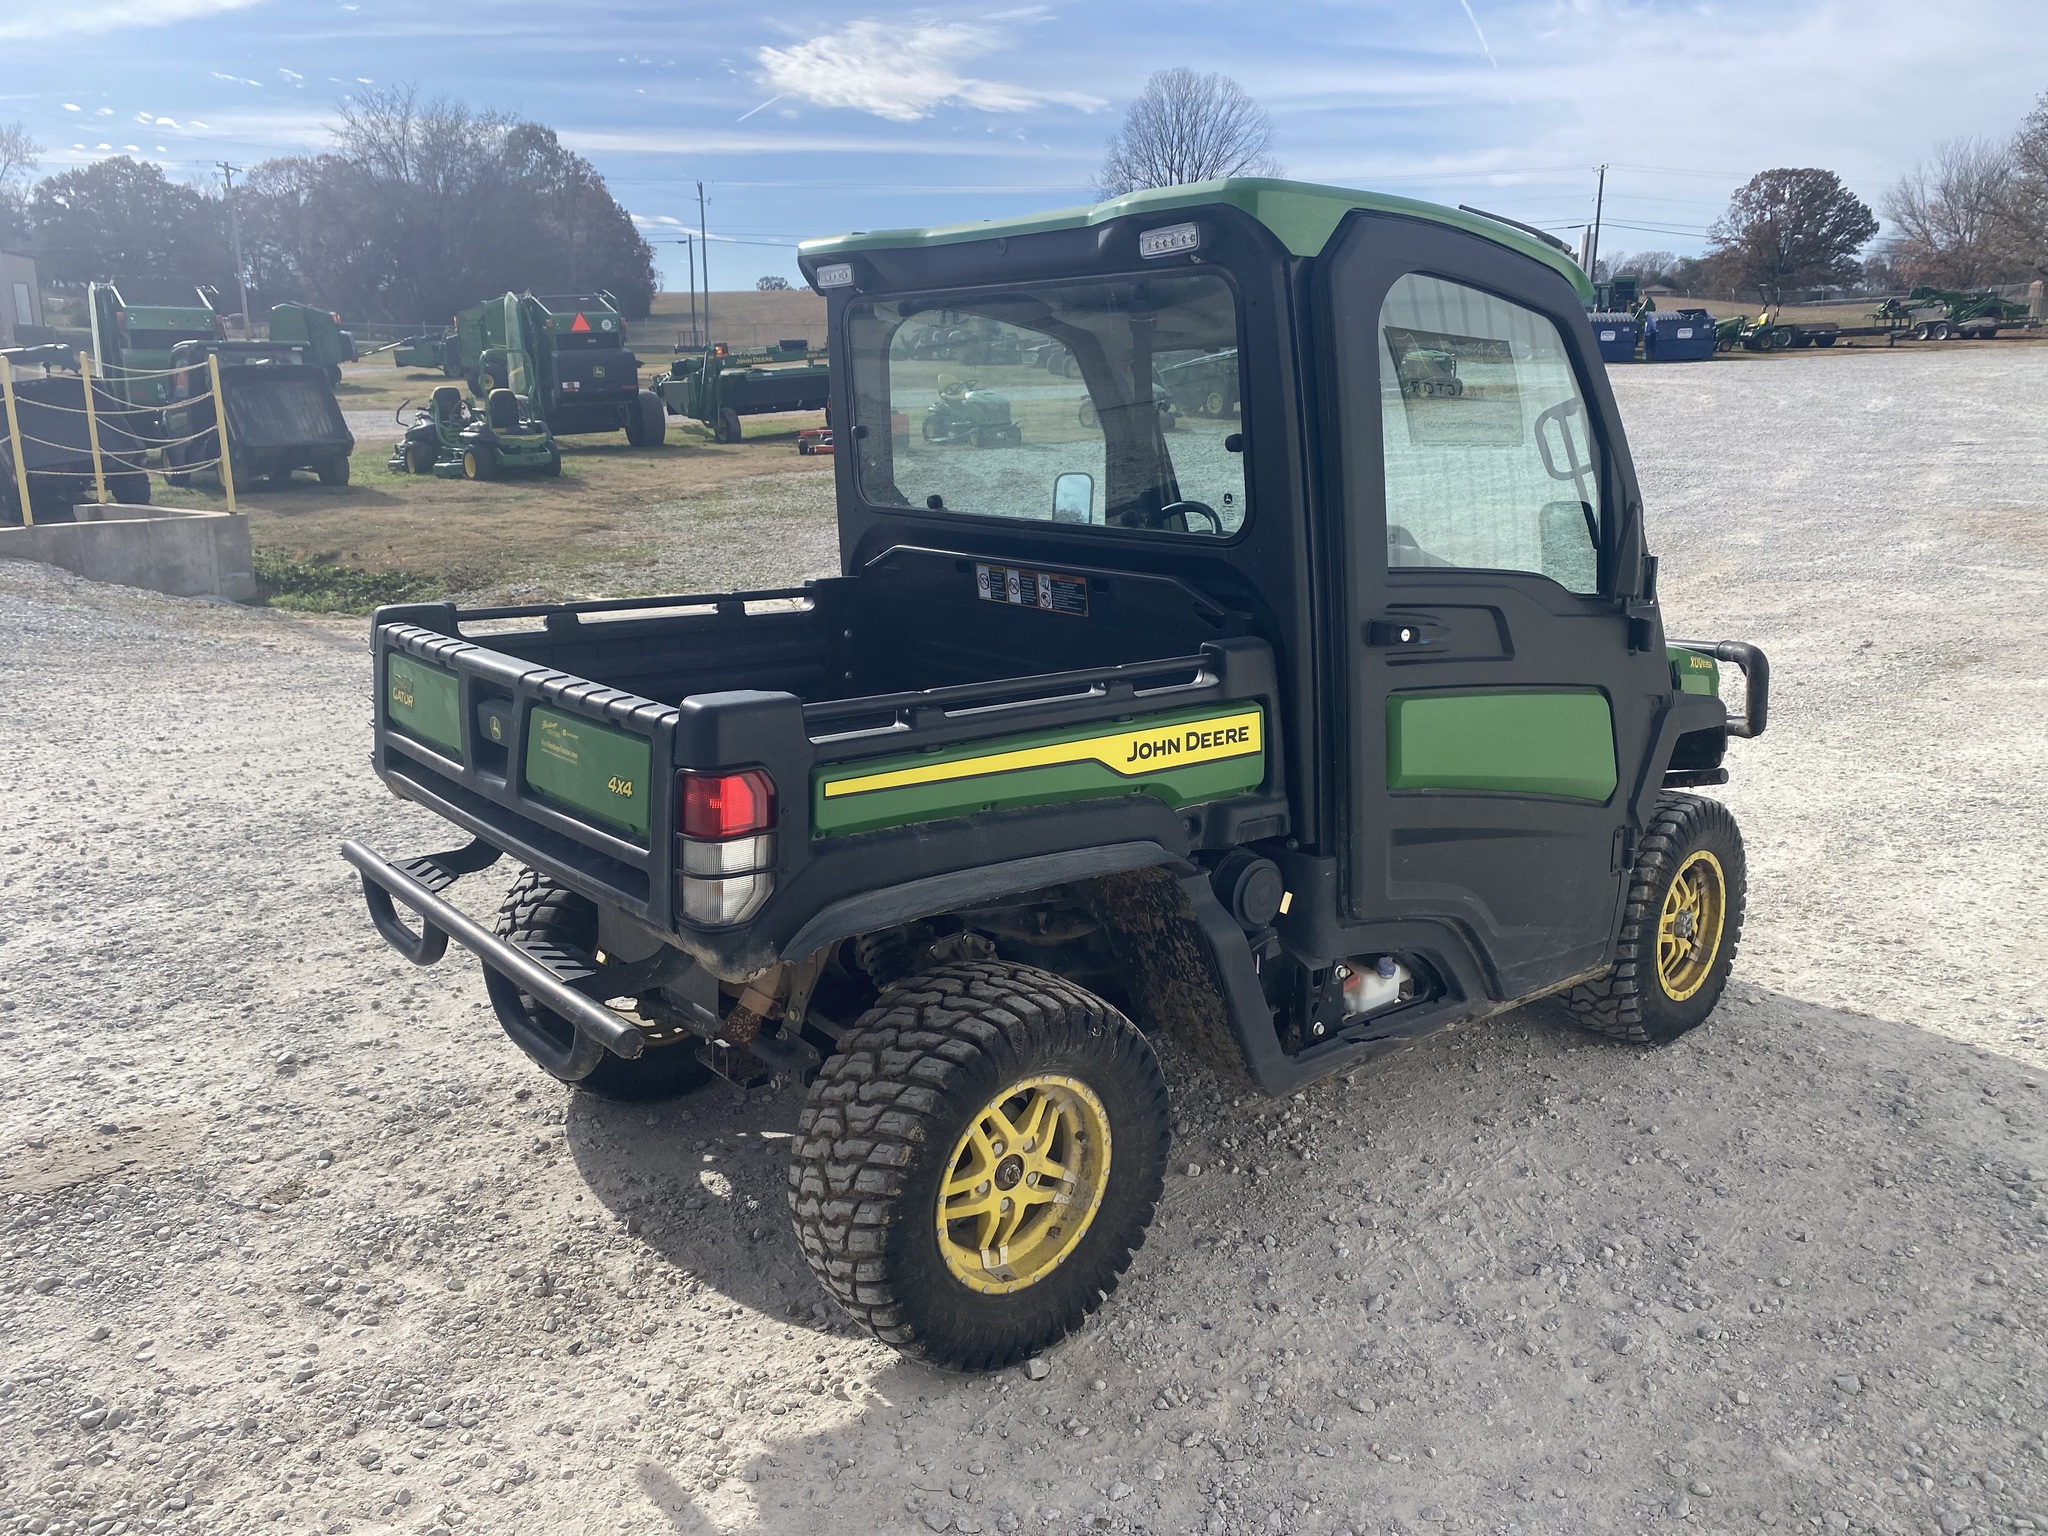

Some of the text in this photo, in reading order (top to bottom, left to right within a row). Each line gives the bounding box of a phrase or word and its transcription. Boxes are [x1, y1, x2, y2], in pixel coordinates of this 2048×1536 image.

[392, 686, 414, 708] GATOR
[1127, 726, 1249, 762] JOHN DEERE
